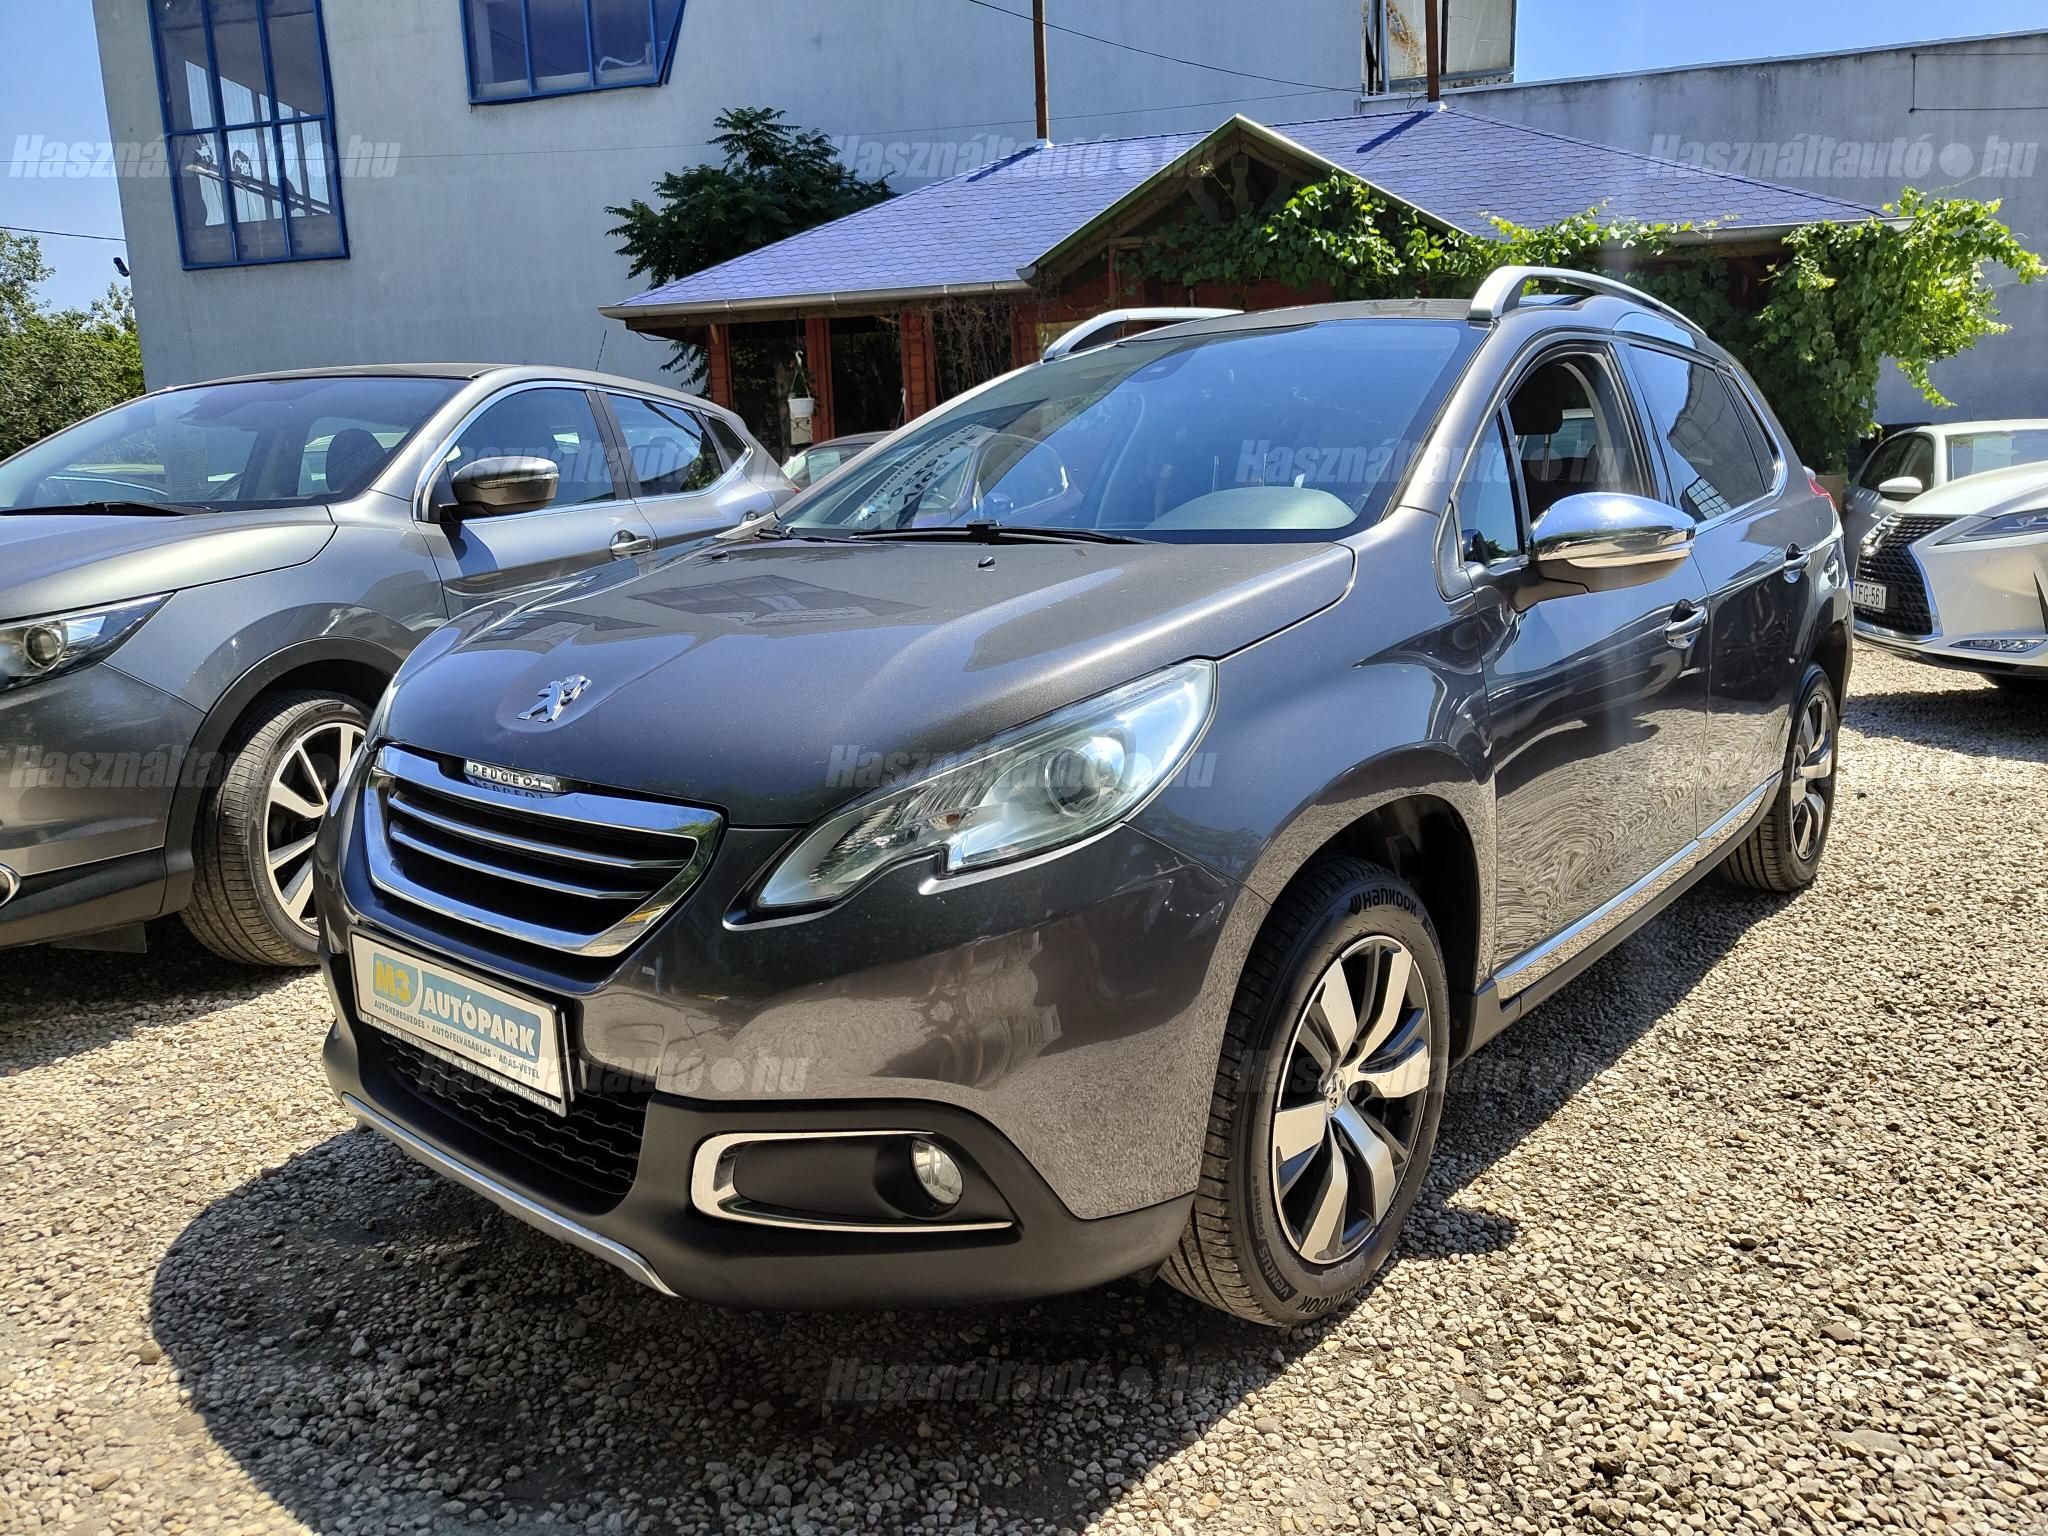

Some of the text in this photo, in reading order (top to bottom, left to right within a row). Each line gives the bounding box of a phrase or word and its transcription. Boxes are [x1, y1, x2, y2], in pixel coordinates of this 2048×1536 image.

[1855, 583, 1884, 607] TFG-561
[472, 764, 545, 788] PEUGEOT
[375, 959, 536, 1057] M3 AUTÓPARK
